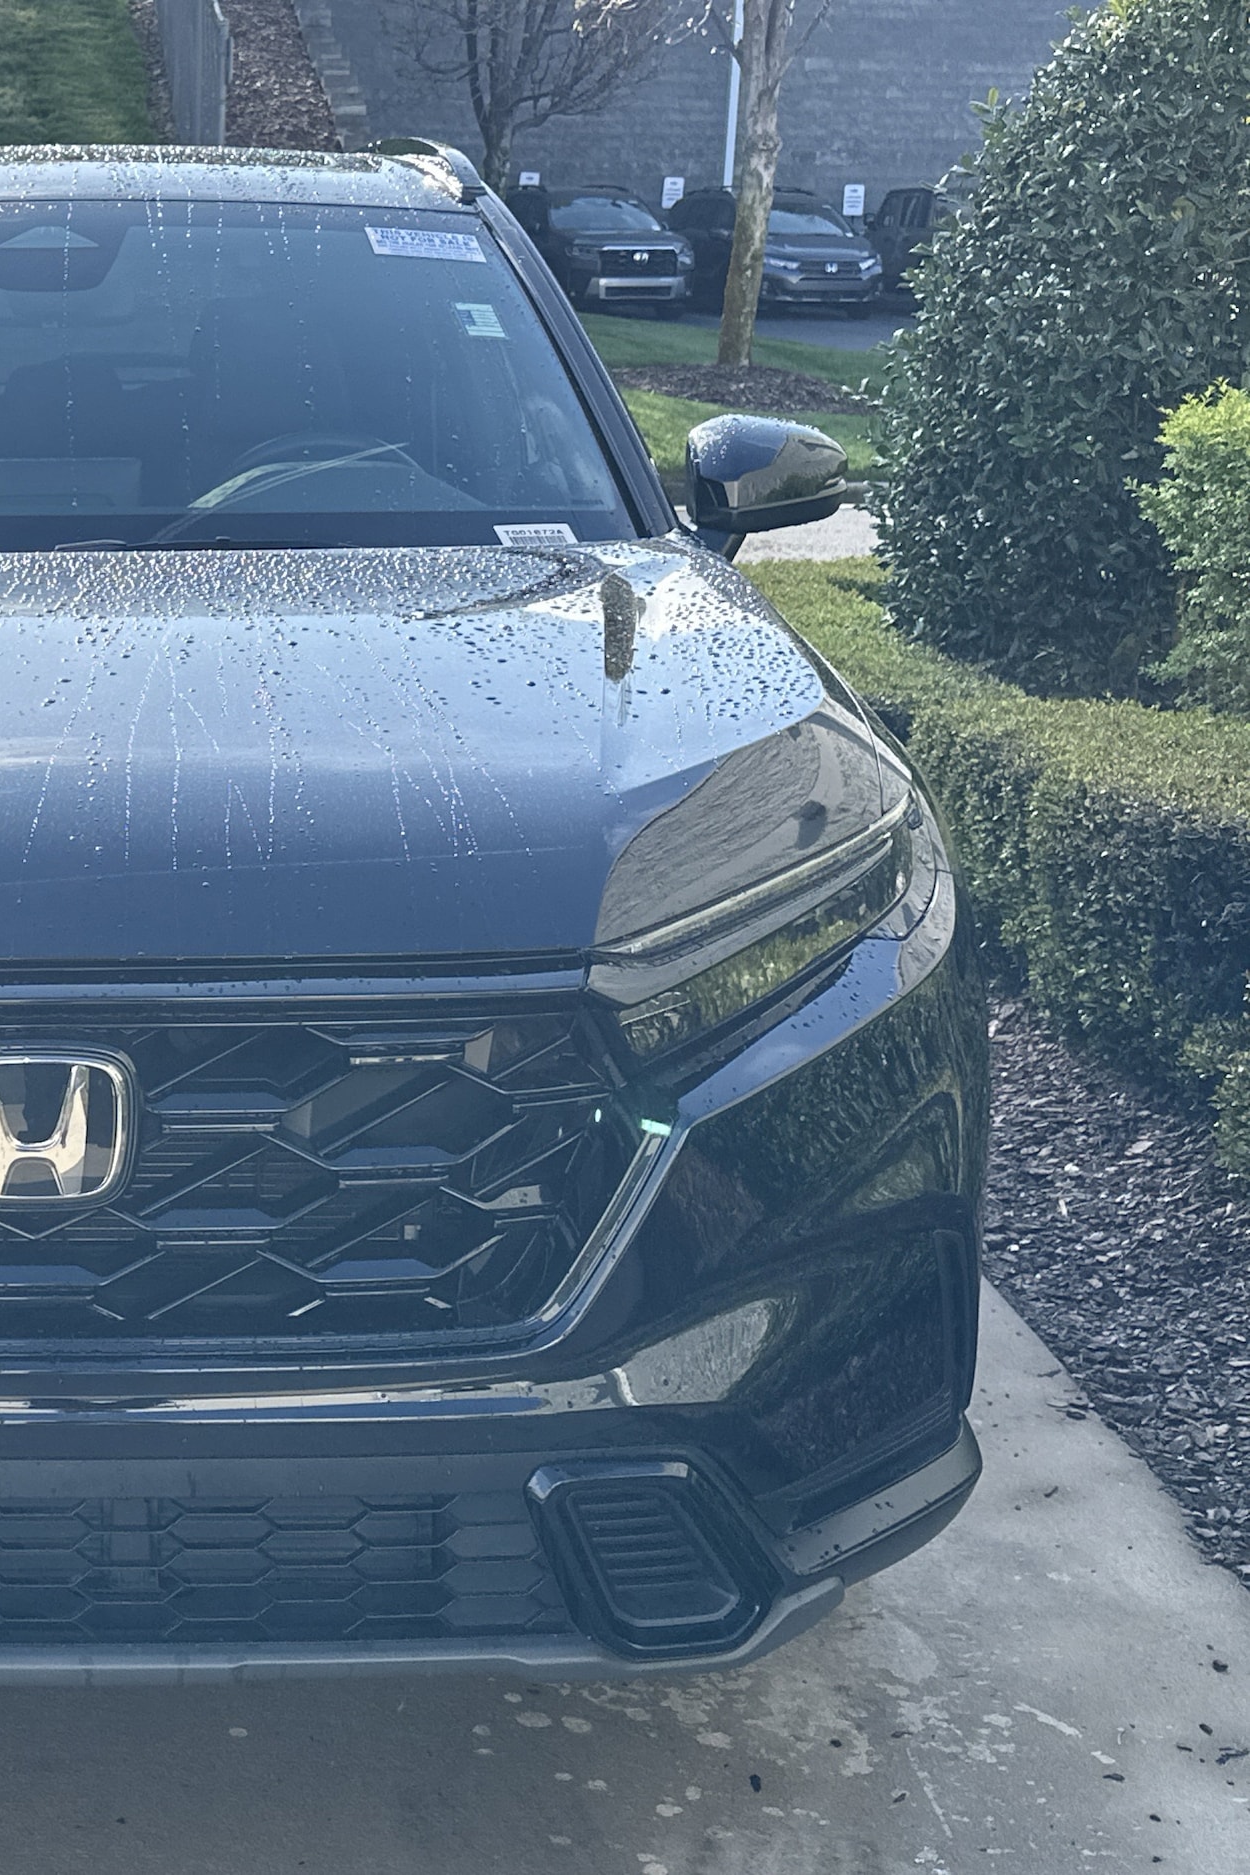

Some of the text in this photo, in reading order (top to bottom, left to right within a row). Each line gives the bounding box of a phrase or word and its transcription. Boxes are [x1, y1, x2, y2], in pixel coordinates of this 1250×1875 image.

[373, 228, 401, 236] THIS
[405, 230, 458, 241] VEHICLE
[410, 236, 435, 244] FOR
[438, 239, 471, 247] SALE
